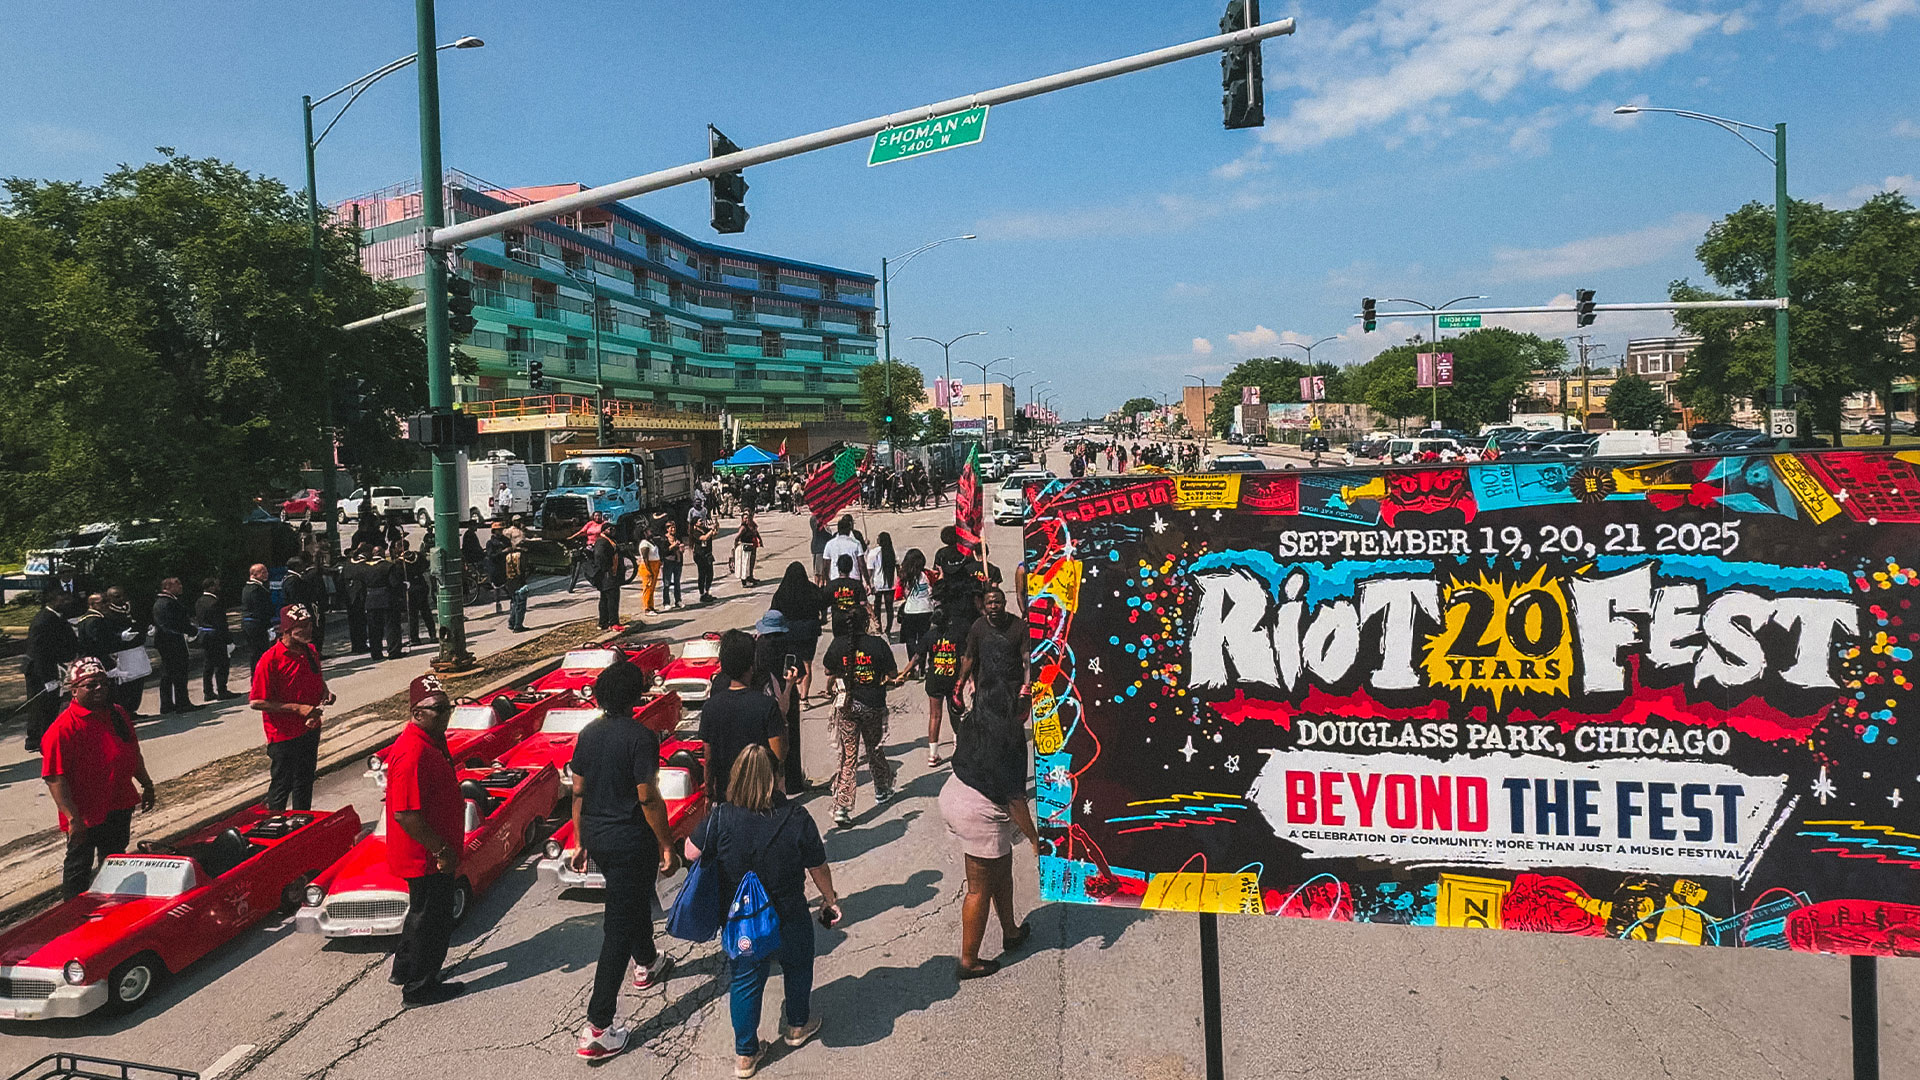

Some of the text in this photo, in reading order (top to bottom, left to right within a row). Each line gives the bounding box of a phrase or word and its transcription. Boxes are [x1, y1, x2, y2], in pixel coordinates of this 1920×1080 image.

[880, 113, 981, 146] S HOMAN AV
[899, 134, 952, 155] 3400 W
[1774, 424, 1794, 434] 30
[1480, 467, 1502, 498] RIOT
[1778, 458, 1824, 513] Cngress
[1279, 519, 1742, 560] SEPTEMBER 19, 20, 21 2025
[834, 590, 854, 598] BLACK
[1447, 585, 1567, 660] 20
[842, 656, 872, 666] BACK
[932, 644, 956, 652] BLACK
[1447, 658, 1562, 682] YEARS
[1297, 720, 1731, 757] DOUGLASS PARK, CHICAGO
[1285, 770, 1745, 844] BEYOND THE FEST
[1289, 830, 1745, 860] A CELEBRATION OF COMMUNITY: MORE THAN JUST A MUSIC FESTIVAL
